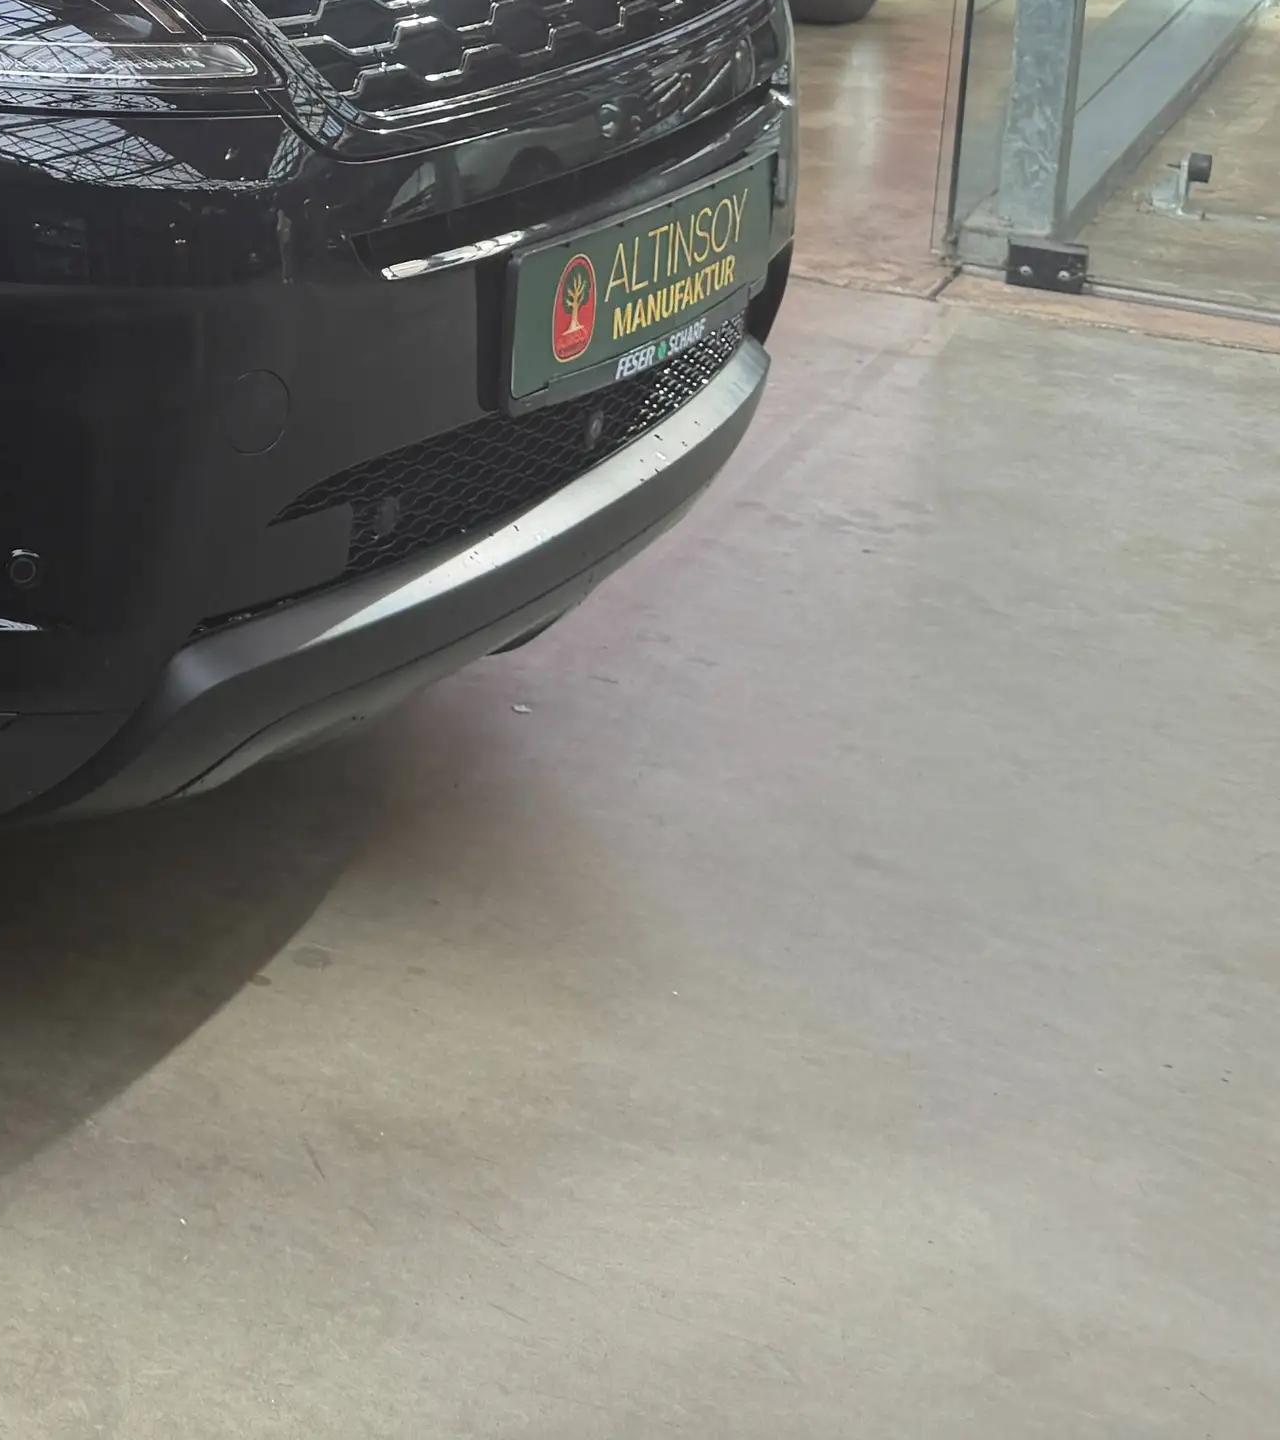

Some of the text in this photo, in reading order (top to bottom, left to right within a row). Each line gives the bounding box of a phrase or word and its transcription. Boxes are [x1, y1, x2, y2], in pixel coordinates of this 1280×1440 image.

[604, 188, 748, 303] ALTINSOY
[613, 255, 736, 340] MANUFAKTUR
[615, 317, 707, 380] FESER SCHARF
